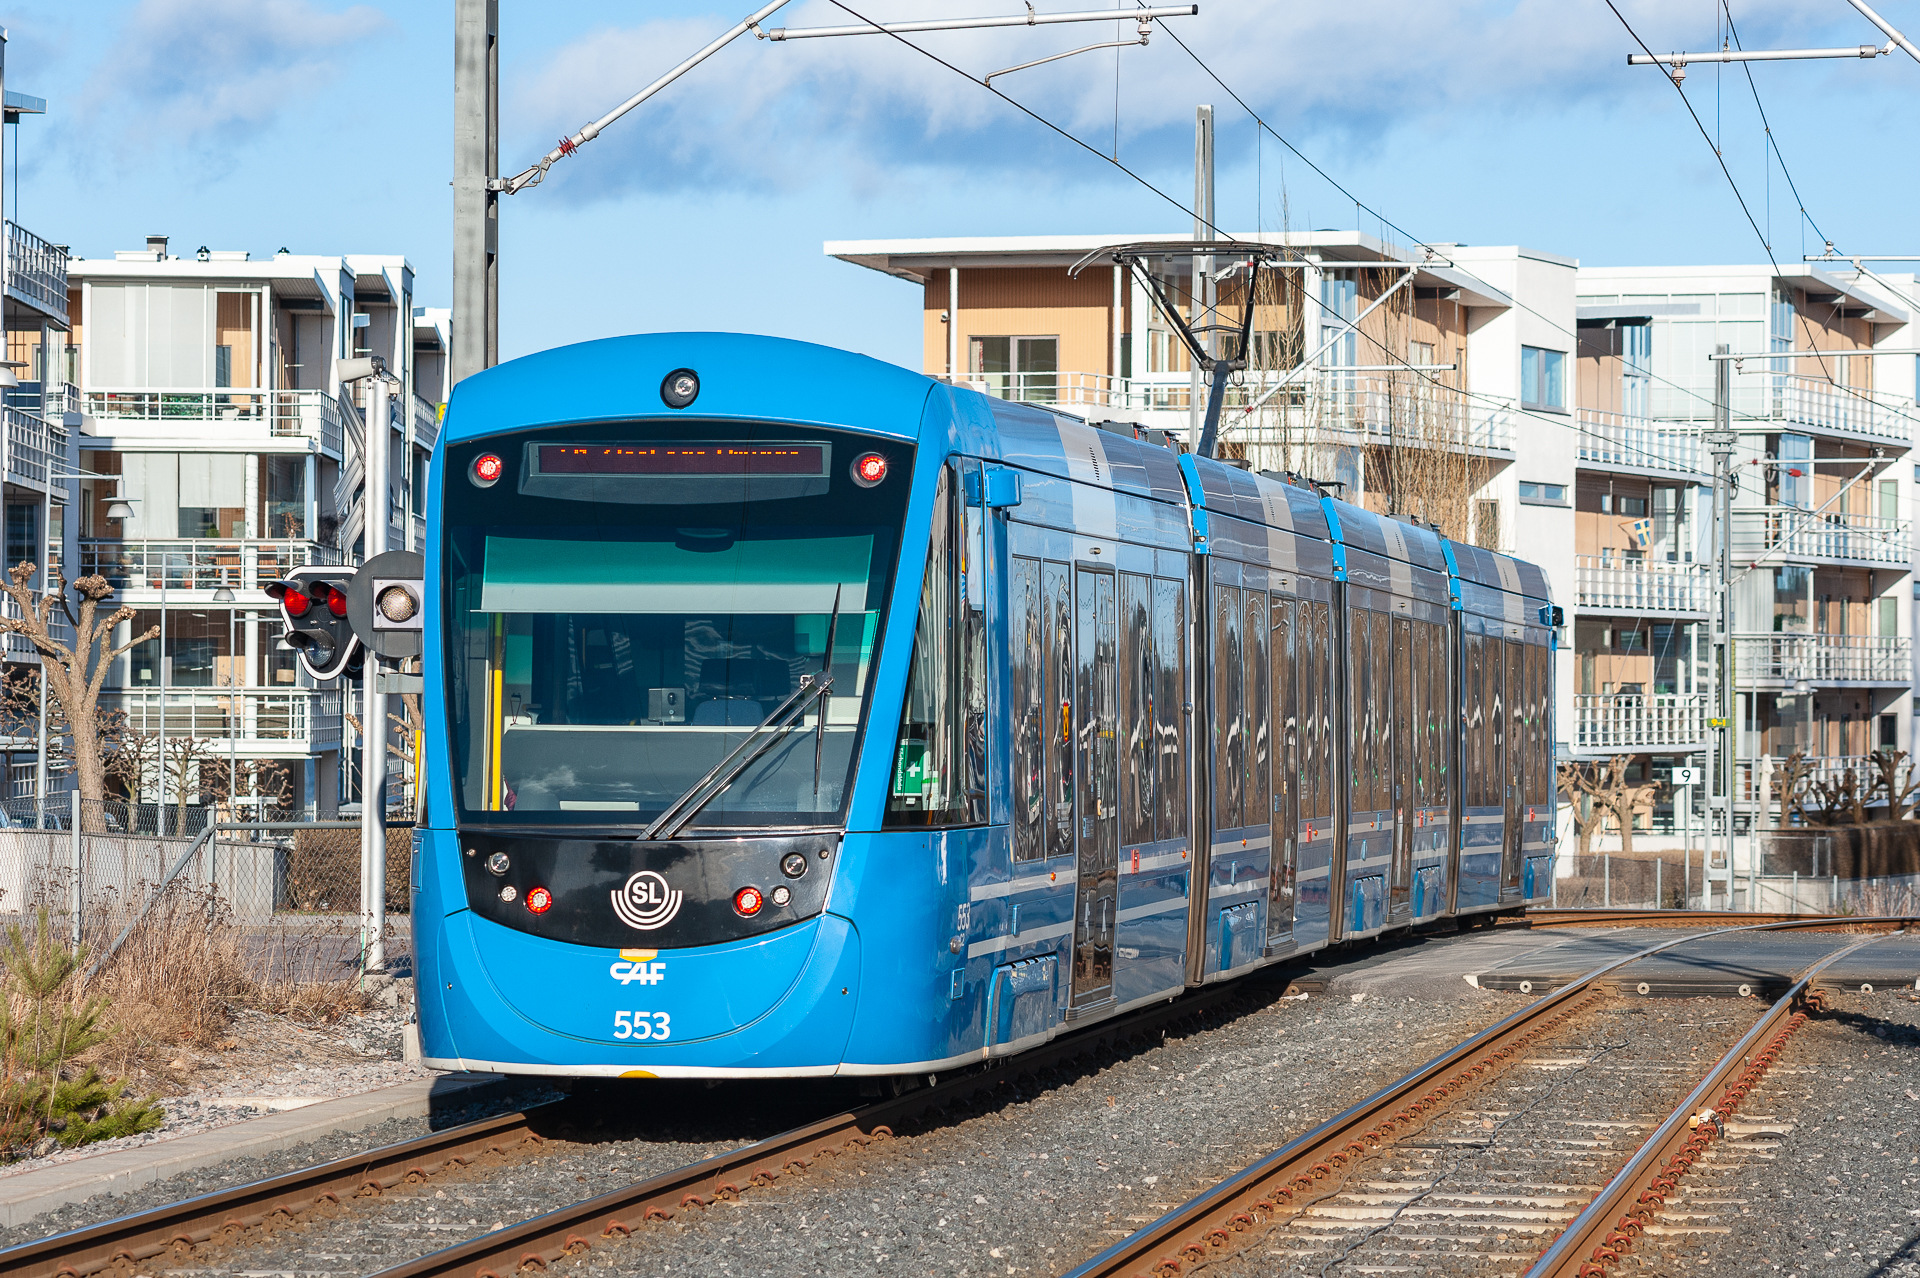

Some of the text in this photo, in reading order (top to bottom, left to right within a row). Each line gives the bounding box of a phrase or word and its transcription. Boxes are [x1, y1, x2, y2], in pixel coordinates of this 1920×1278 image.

[1681, 769, 1691, 782] 9
[631, 881, 662, 904] SL
[957, 902, 971, 931] 553
[609, 962, 667, 986] CAF
[613, 1010, 671, 1040] 553
